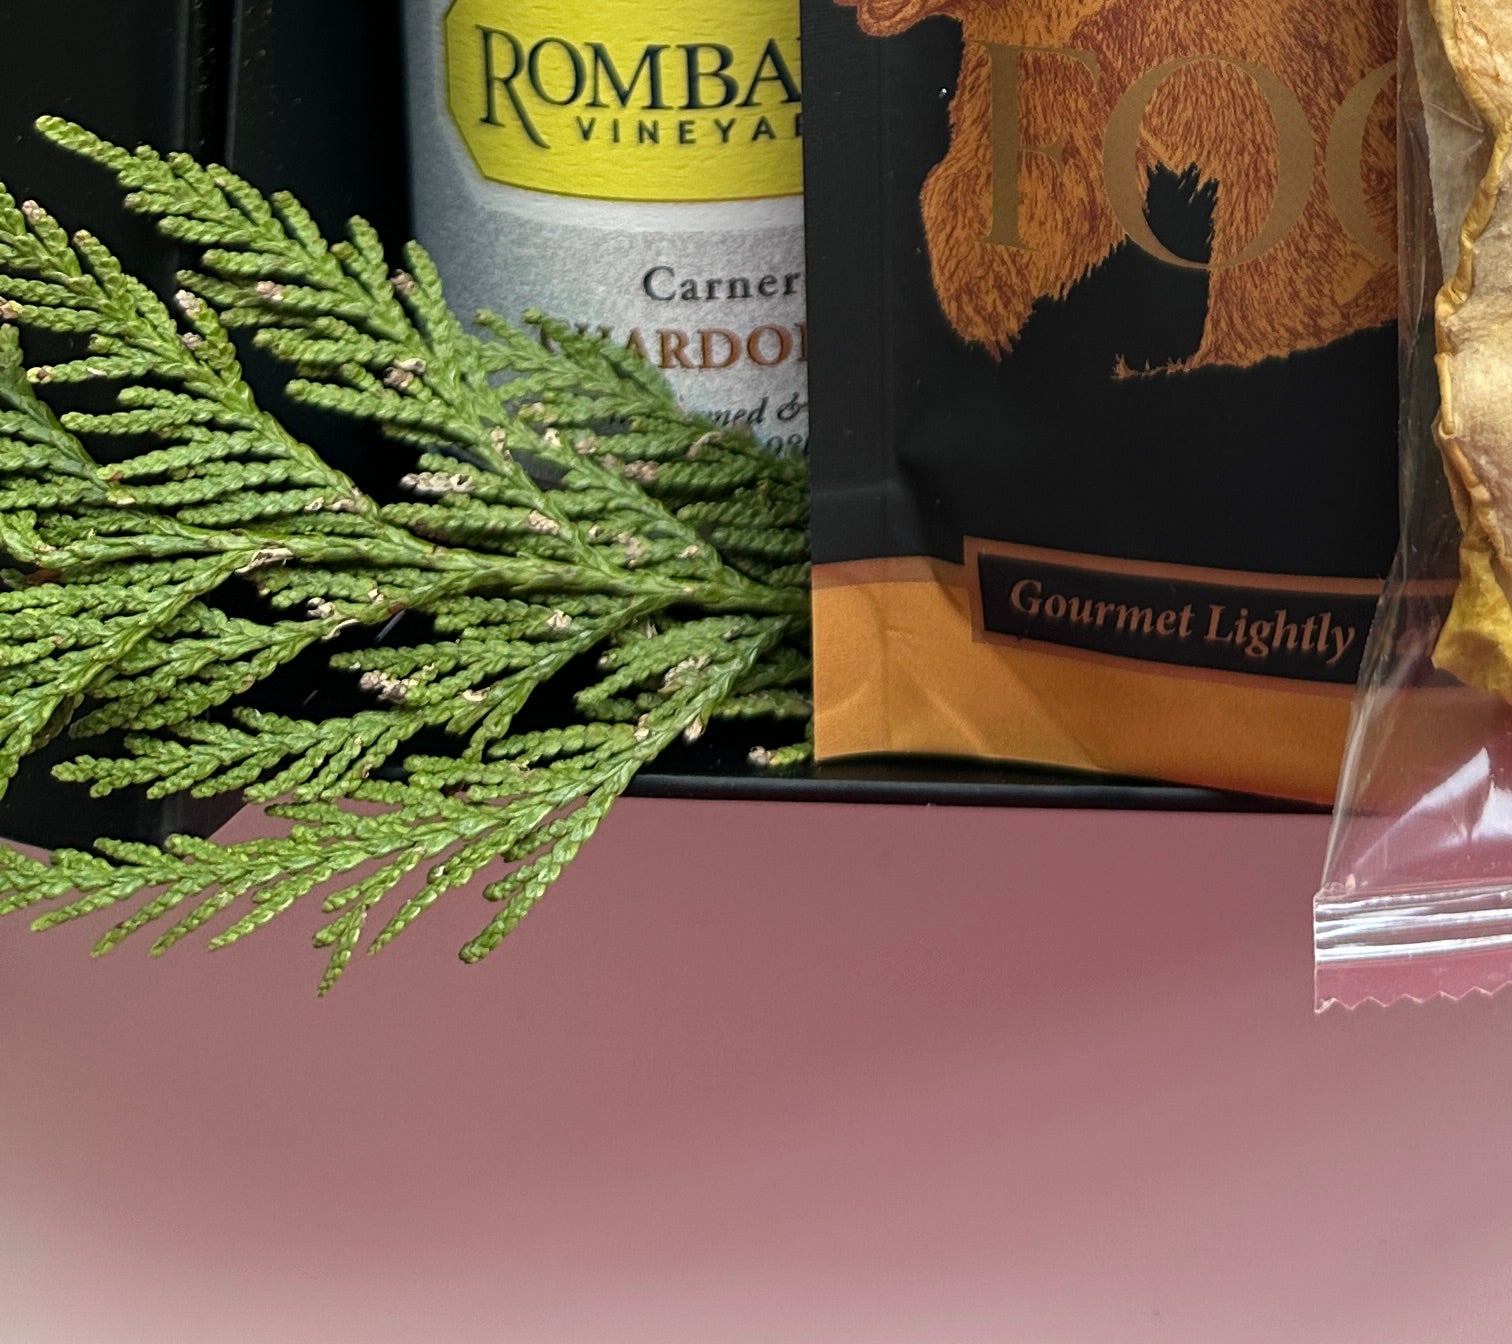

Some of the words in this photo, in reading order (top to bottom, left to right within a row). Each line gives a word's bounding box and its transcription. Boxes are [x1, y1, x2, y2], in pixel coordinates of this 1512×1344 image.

[475, 23, 803, 149] ROMBA
[576, 112, 804, 145] VINEYA
[642, 265, 800, 302] Carner
[578, 317, 808, 370] ARDO
[1009, 577, 1195, 640] Gourmet
[1203, 604, 1357, 665] Lightly
